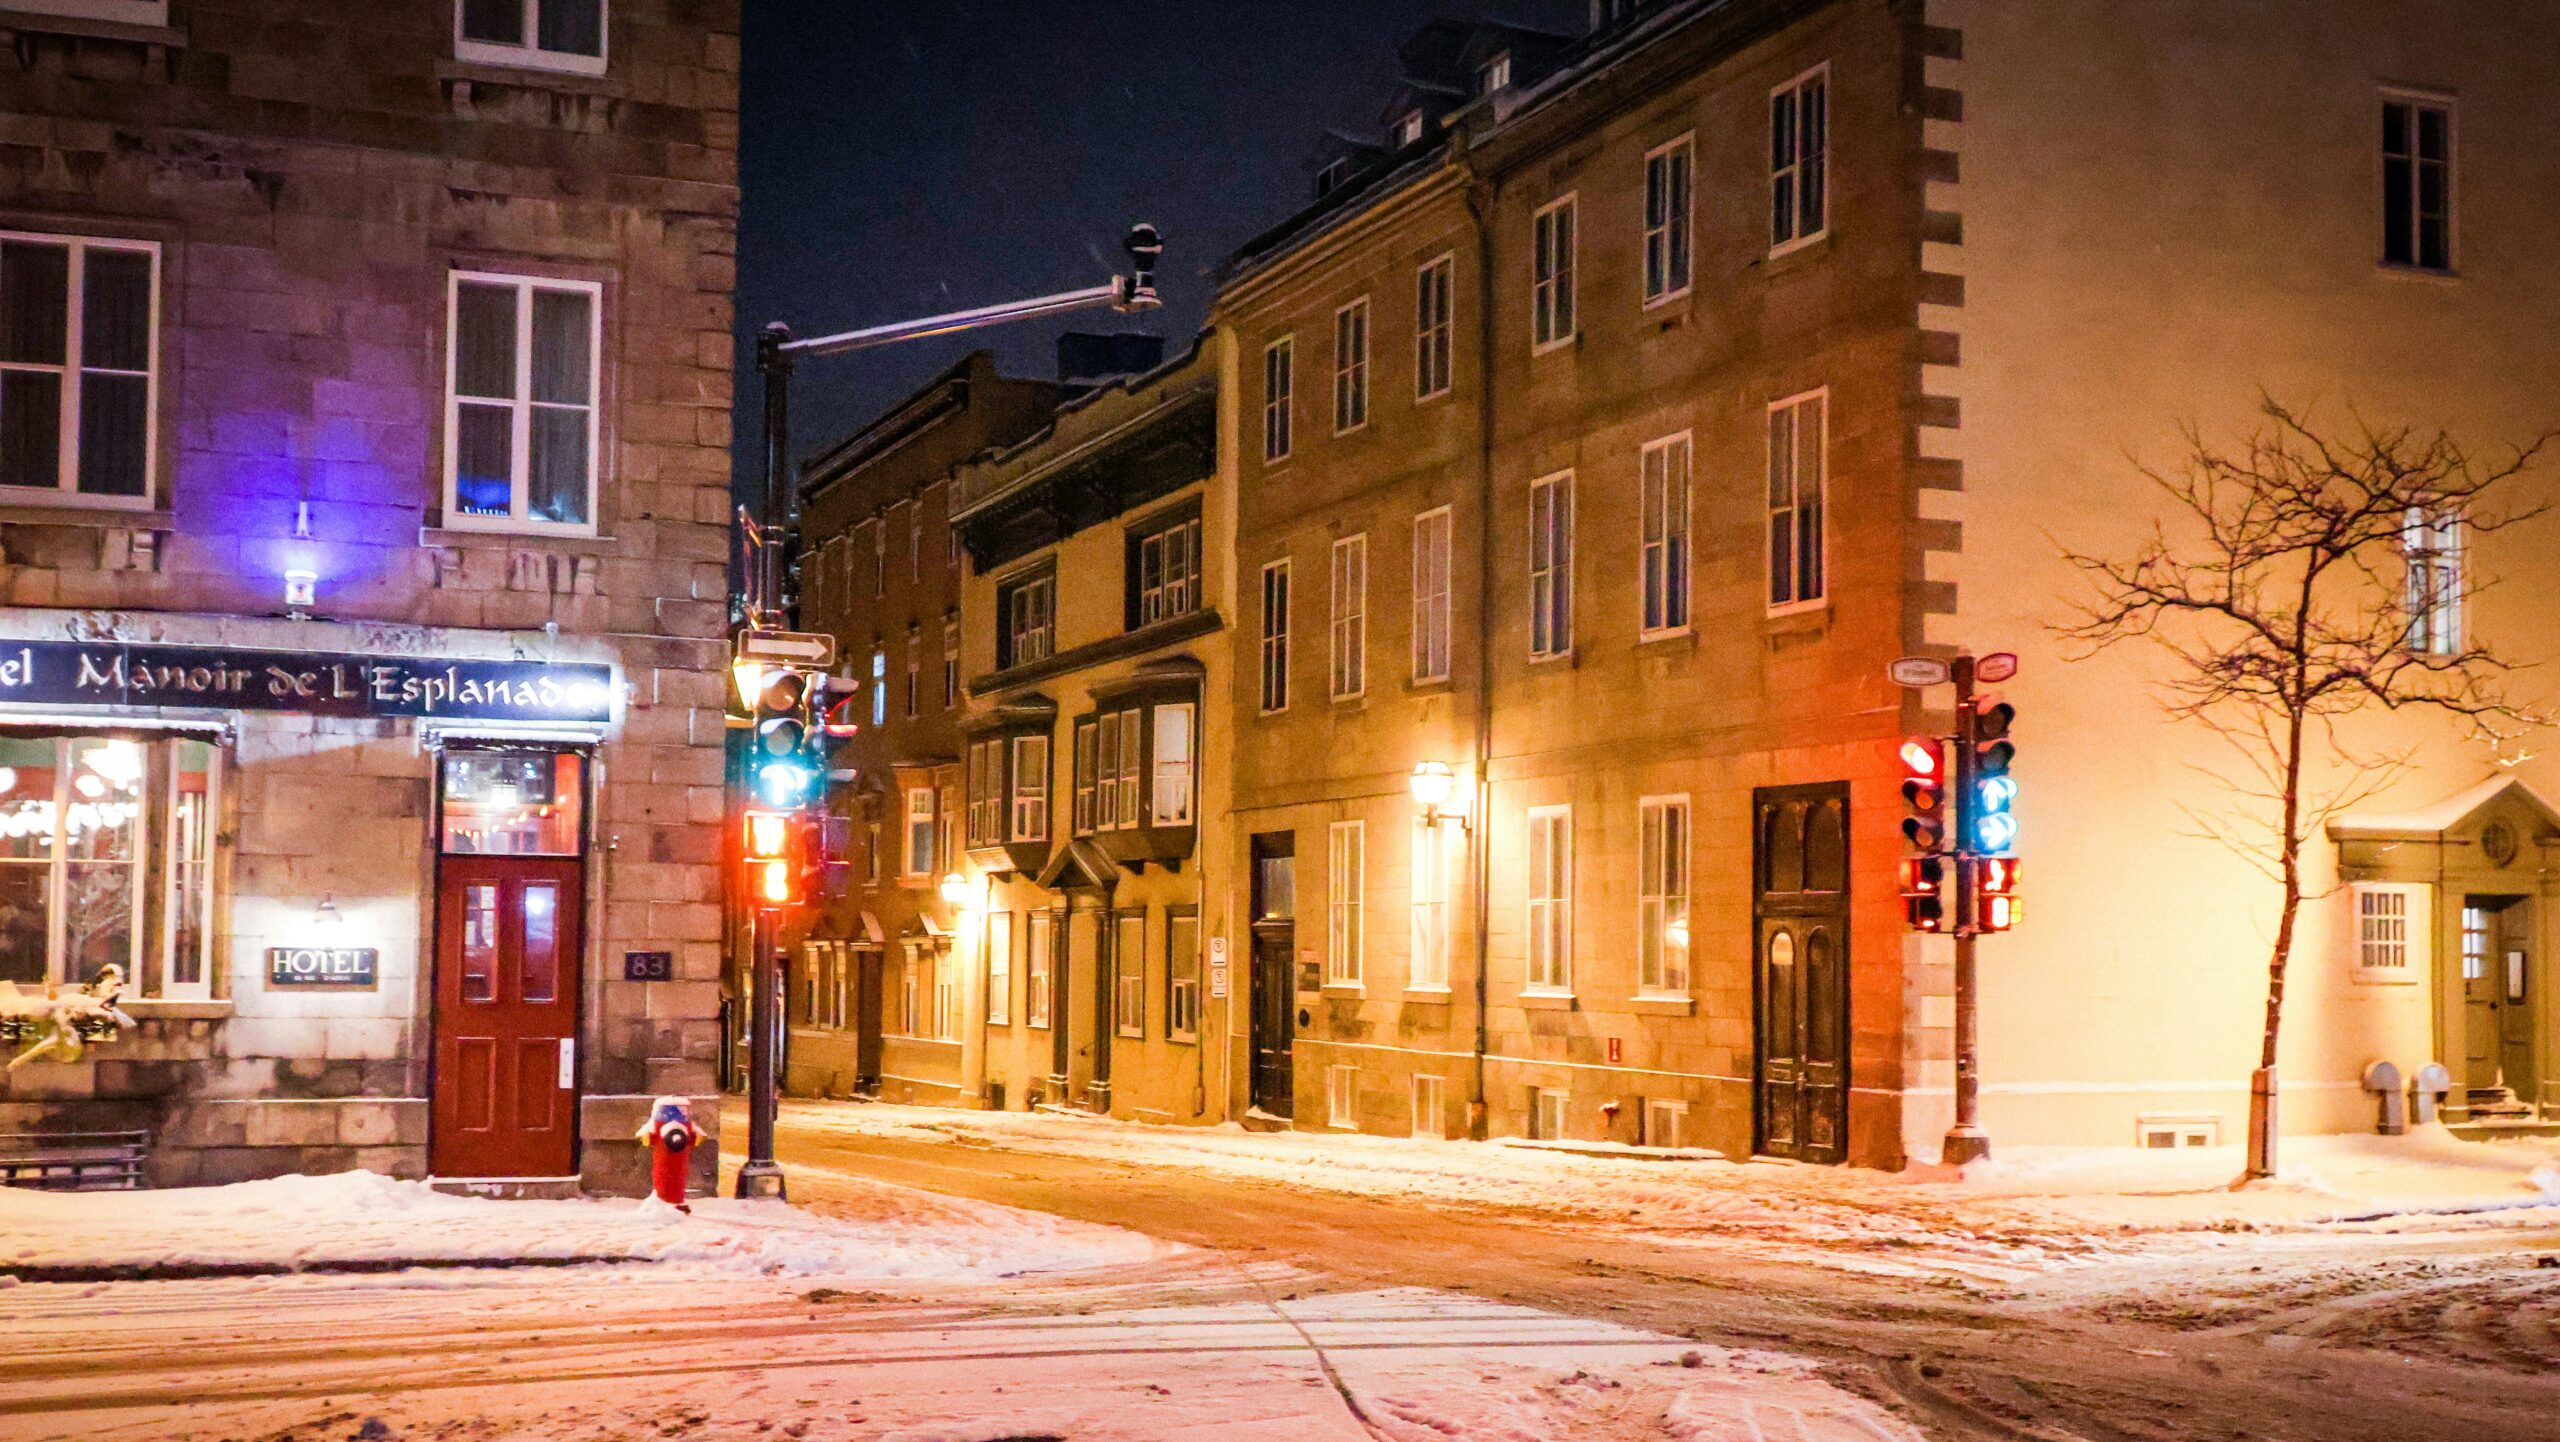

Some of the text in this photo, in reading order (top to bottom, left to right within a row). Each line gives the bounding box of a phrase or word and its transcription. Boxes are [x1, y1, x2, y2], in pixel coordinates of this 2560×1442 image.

[76, 652, 250, 692] Manoir
[265, 665, 317, 697] de
[272, 950, 370, 974] HOTEL
[633, 955, 664, 976] 83
